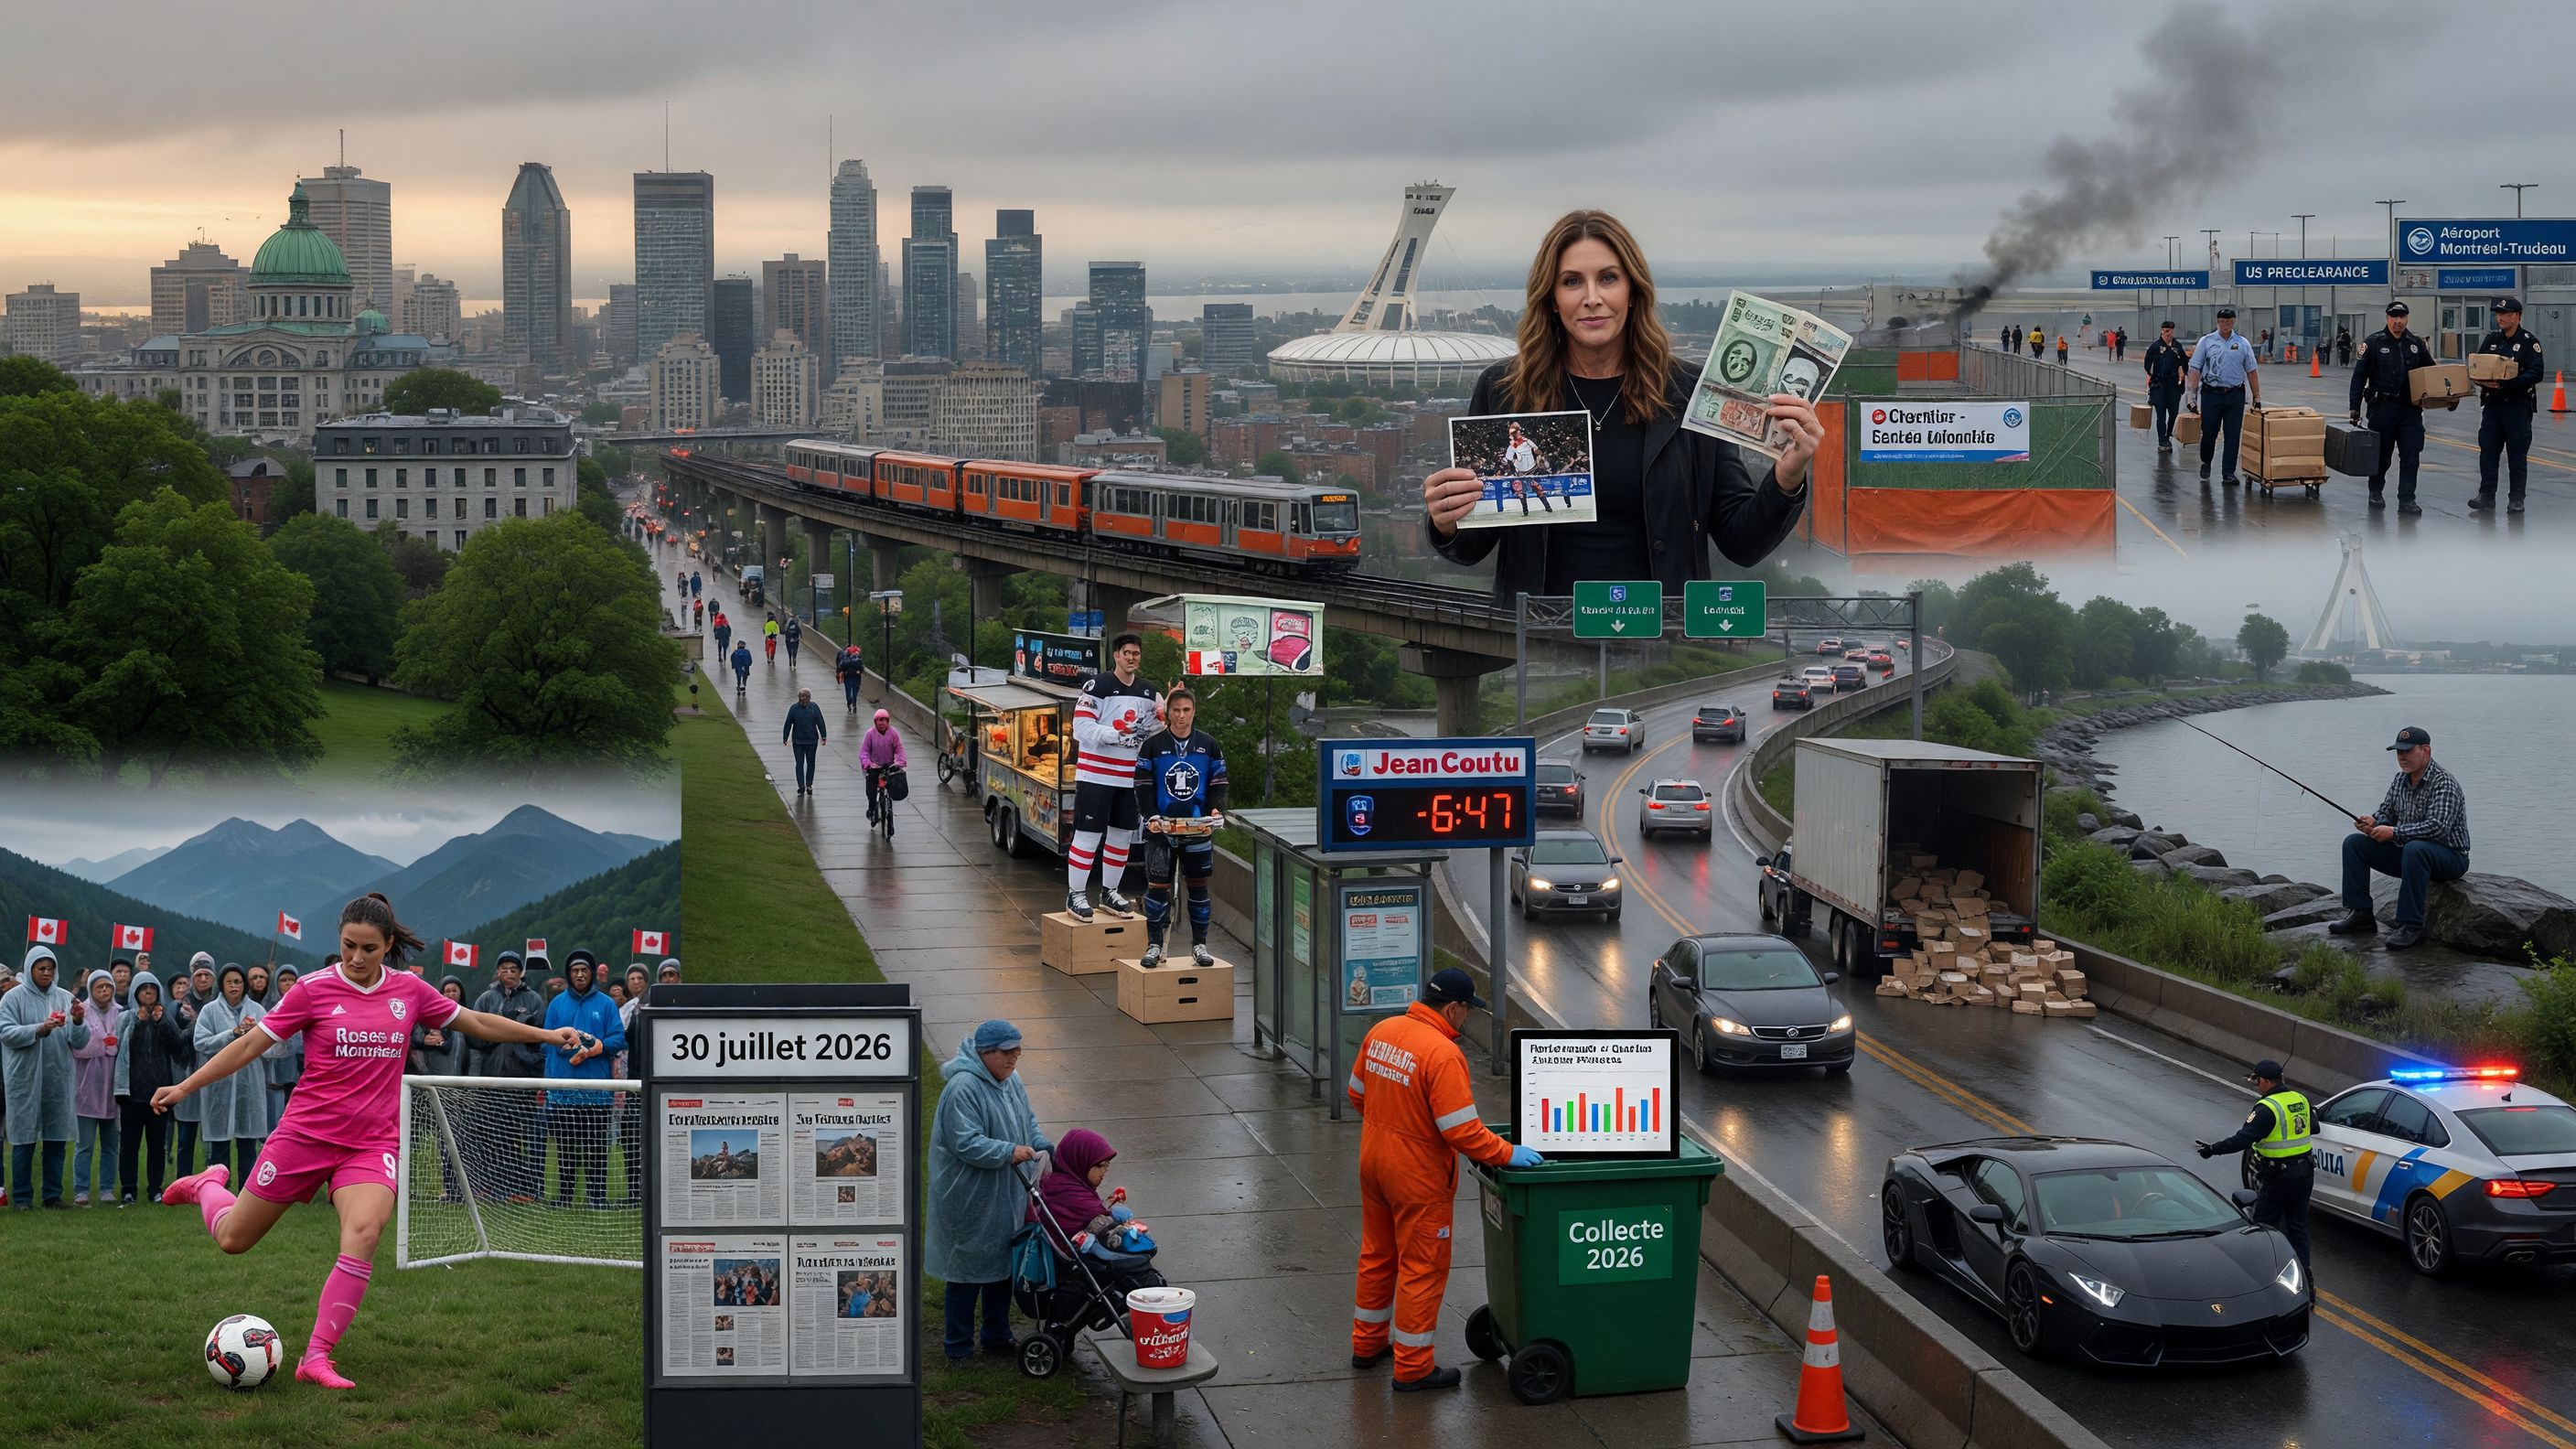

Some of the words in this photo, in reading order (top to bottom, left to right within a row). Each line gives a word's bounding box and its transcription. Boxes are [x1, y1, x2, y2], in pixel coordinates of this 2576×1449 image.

[2440, 226, 2501, 241] Aéroport
[2246, 266, 2263, 278] US
[2268, 265, 2369, 279] PRECLEARANCE
[1372, 751, 1438, 775] Jean
[1441, 751, 1519, 774] Coutu
[671, 1033, 710, 1060] 30
[715, 1031, 807, 1068] juillet
[815, 1033, 892, 1060] 2026
[1569, 1218, 1664, 1244] Collecte
[1586, 1246, 1644, 1270] 2026
